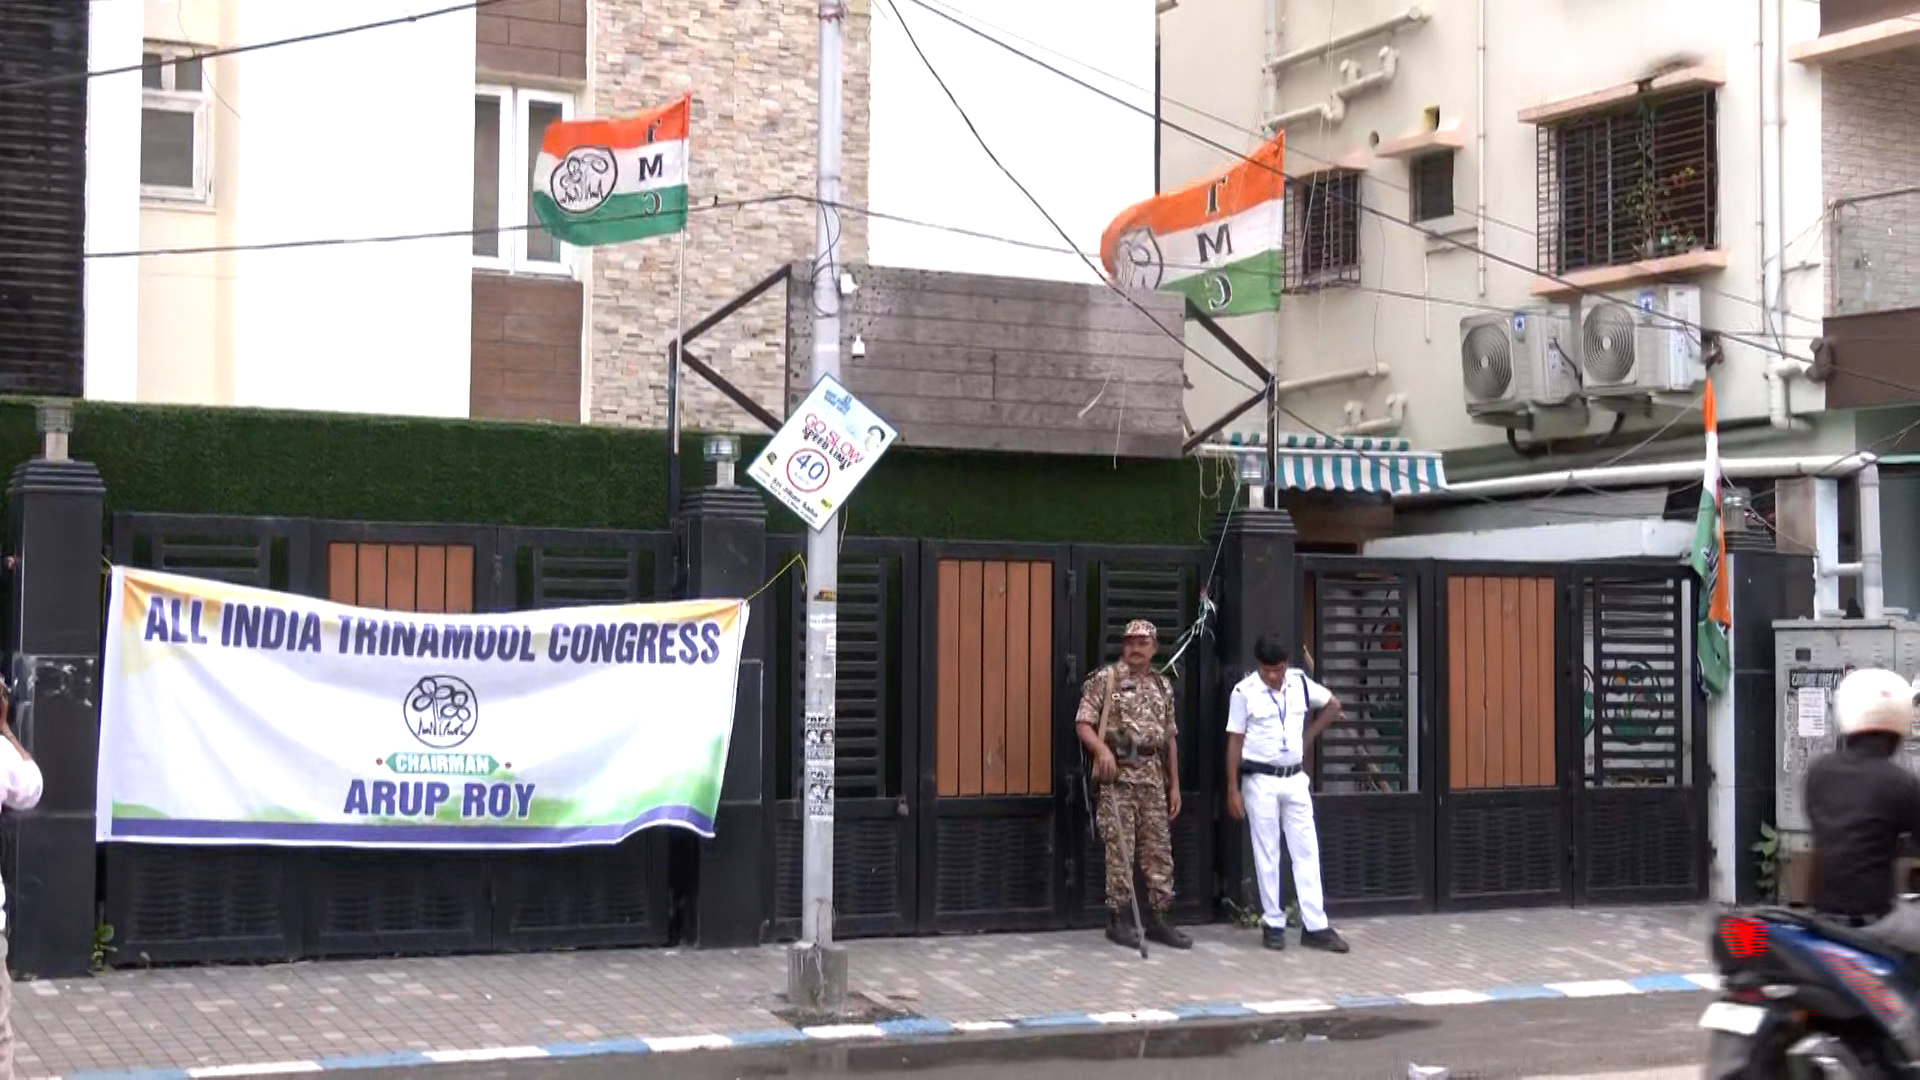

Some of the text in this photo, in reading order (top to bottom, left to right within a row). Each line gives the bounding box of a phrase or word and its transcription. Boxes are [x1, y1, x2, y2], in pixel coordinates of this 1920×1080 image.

[805, 413, 866, 464] GO SLOW
[796, 453, 825, 480] 40
[144, 597, 720, 665] ALL INDIA TRINAMOOL CONGRESS
[395, 754, 489, 774] CHAIRMAN
[343, 779, 536, 818] ARUP ROY
